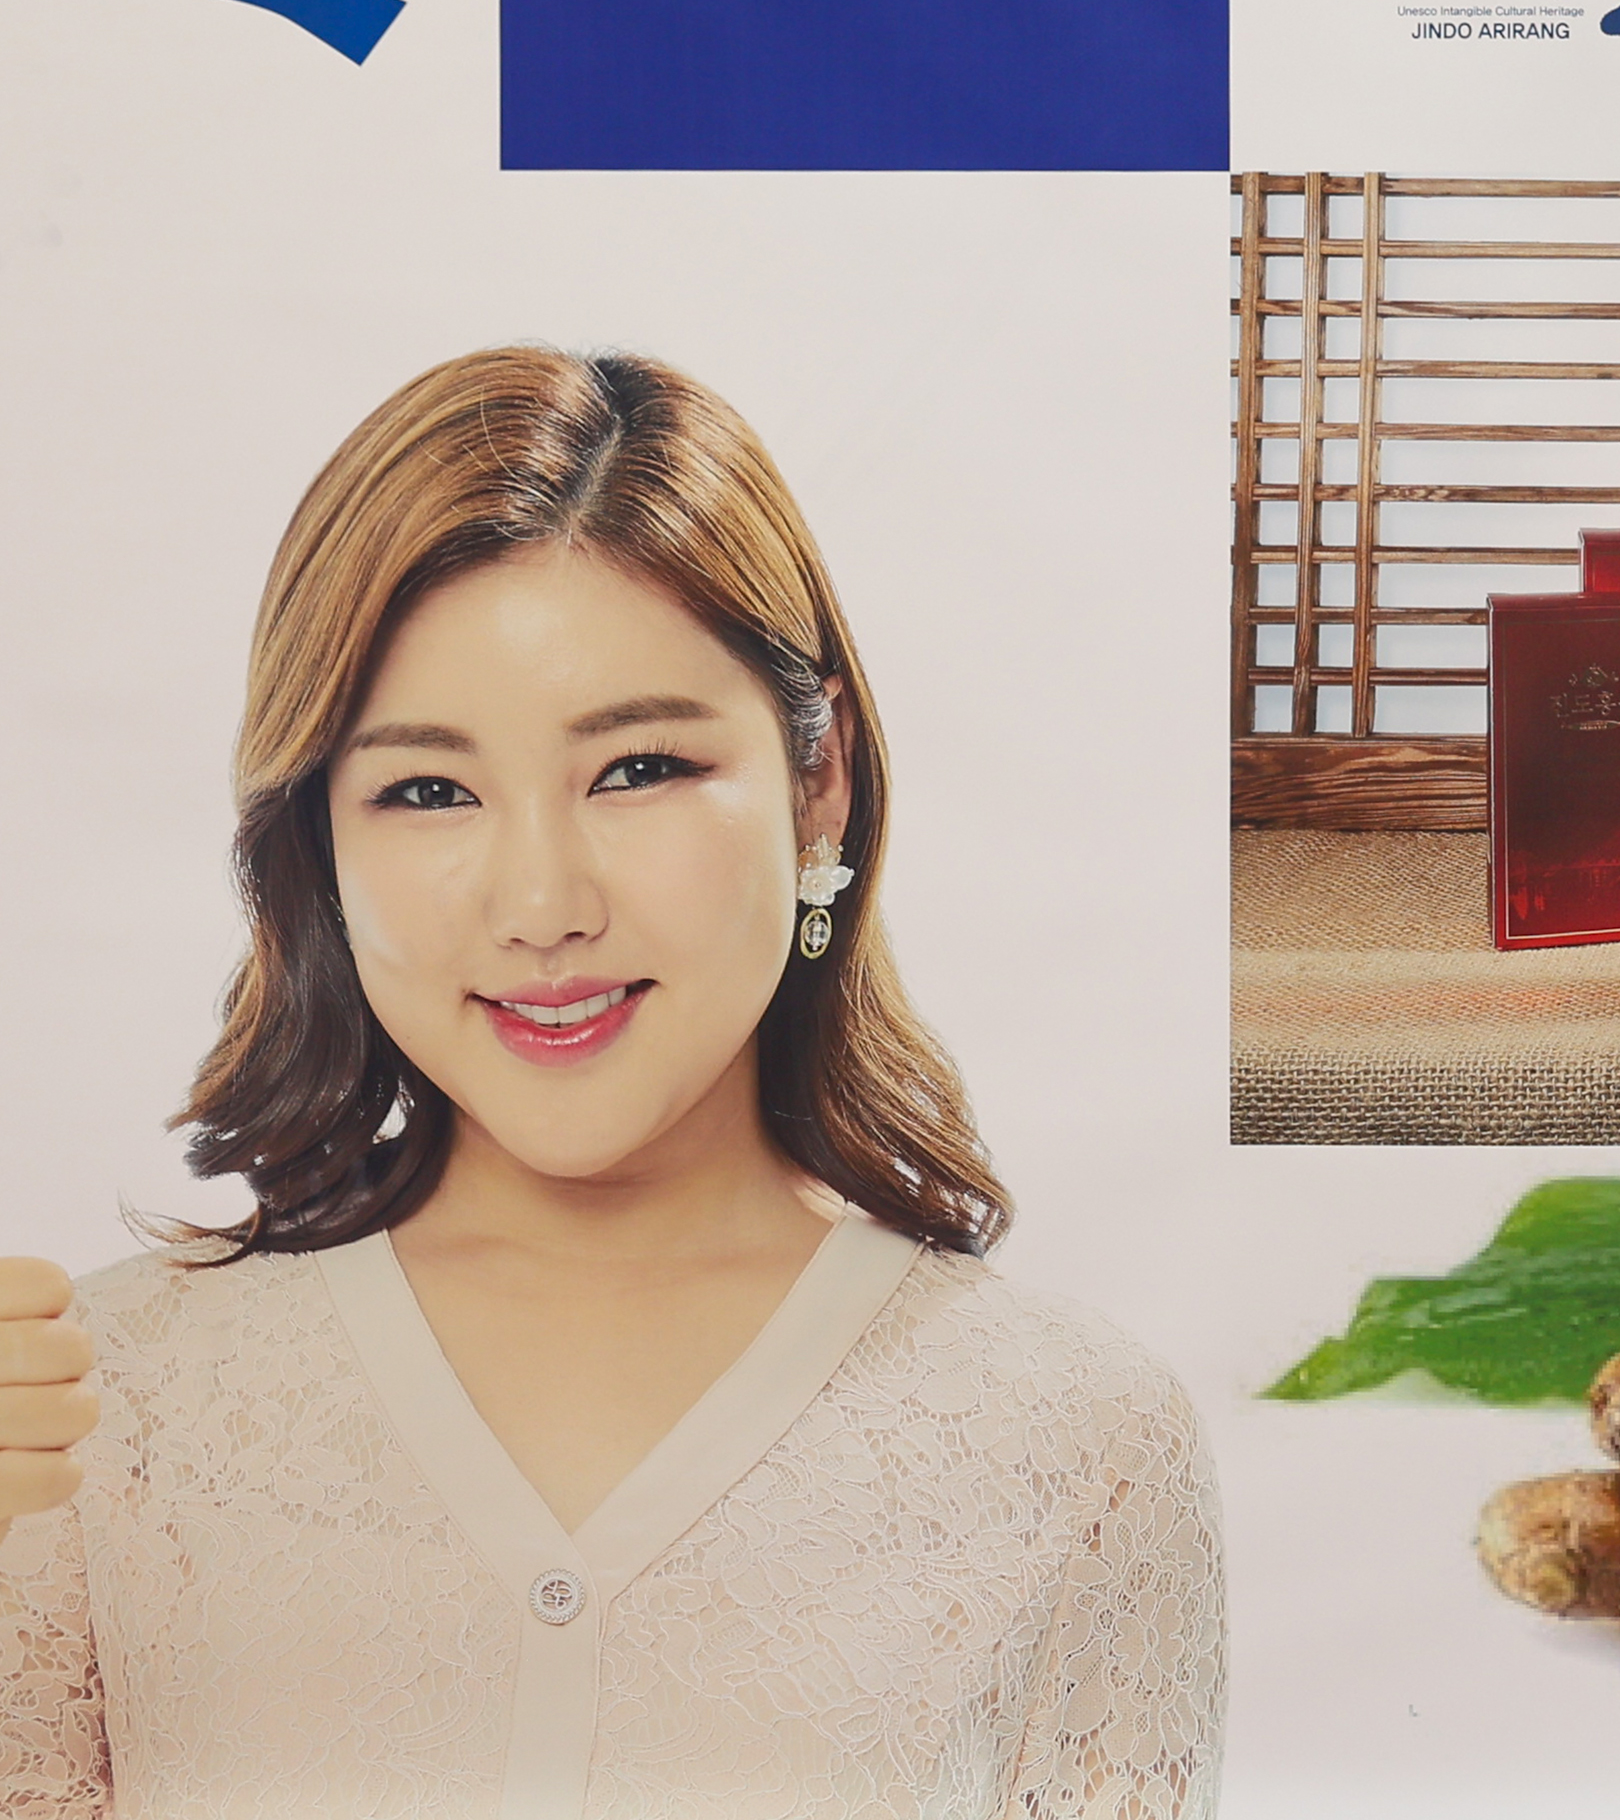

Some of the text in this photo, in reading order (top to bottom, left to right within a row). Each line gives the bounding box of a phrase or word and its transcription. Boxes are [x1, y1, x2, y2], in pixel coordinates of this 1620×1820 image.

[1397, 6, 1585, 18] Unesco Intangible Cultural Heritage
[1411, 22, 1571, 40] JINDO ARIRANG
